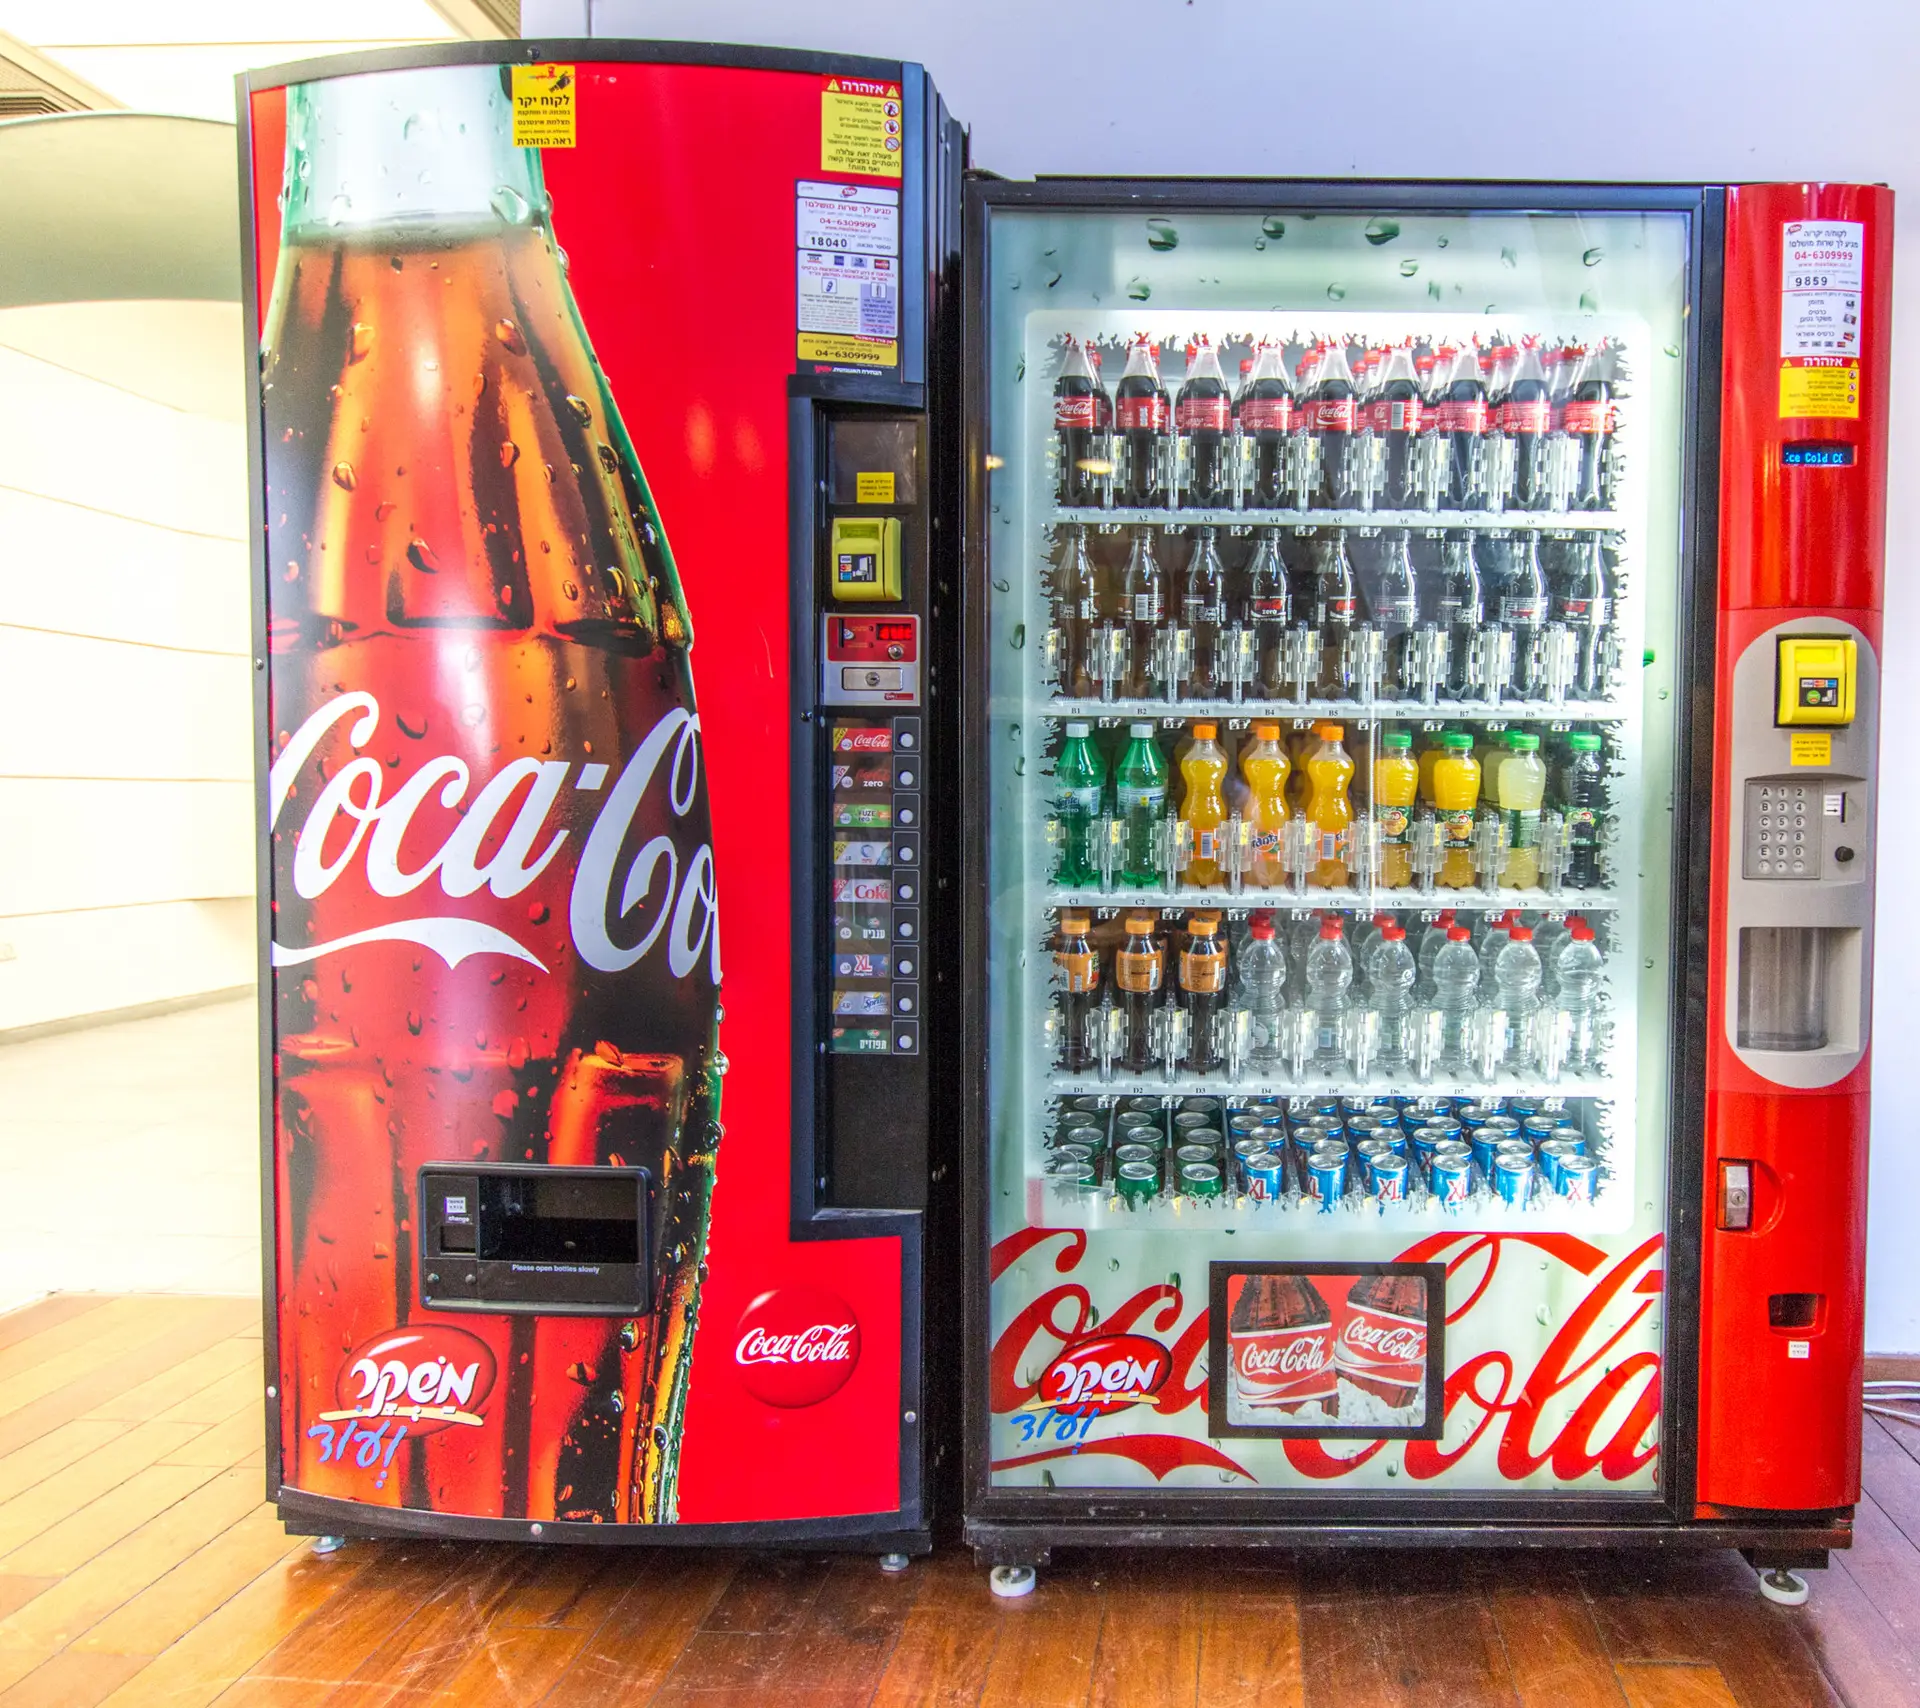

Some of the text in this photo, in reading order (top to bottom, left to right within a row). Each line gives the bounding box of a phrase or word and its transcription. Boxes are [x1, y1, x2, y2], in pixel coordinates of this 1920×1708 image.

[842, 80, 884, 95] אזהרה
[517, 95, 570, 108] לקוח יקר
[819, 217, 877, 228] 04-6309999
[811, 236, 847, 248] 18040
[1794, 250, 1853, 260] 04-6309999
[1795, 276, 1828, 287] 9859
[815, 349, 880, 361] 04-6309999
[1803, 356, 1843, 367] אזהרה
[1805, 451, 1828, 463] Cold
[854, 734, 890, 748] Coca-Cola
[1761, 788, 1769, 797] A
[1796, 788, 1803, 797] 2
[1762, 803, 1802, 811] B 3 4
[1761, 818, 1802, 826] C 5 6
[1761, 833, 1802, 841] D 7 8
[1761, 847, 1767, 856] E
[1778, 847, 1784, 856] 9
[854, 954, 873, 972] XL
[860, 1039, 887, 1050] תפוזים
[1248, 1177, 1271, 1200] XL
[1378, 1179, 1400, 1200] XL
[512, 1264, 535, 1272] Please
[554, 1265, 577, 1273] bottles
[578, 1265, 600, 1275] slowly
[1344, 1316, 1426, 1360] Coca-Cola
[735, 1324, 856, 1365] Coca-Cola
[1241, 1336, 1326, 1376] Coca-Cola
